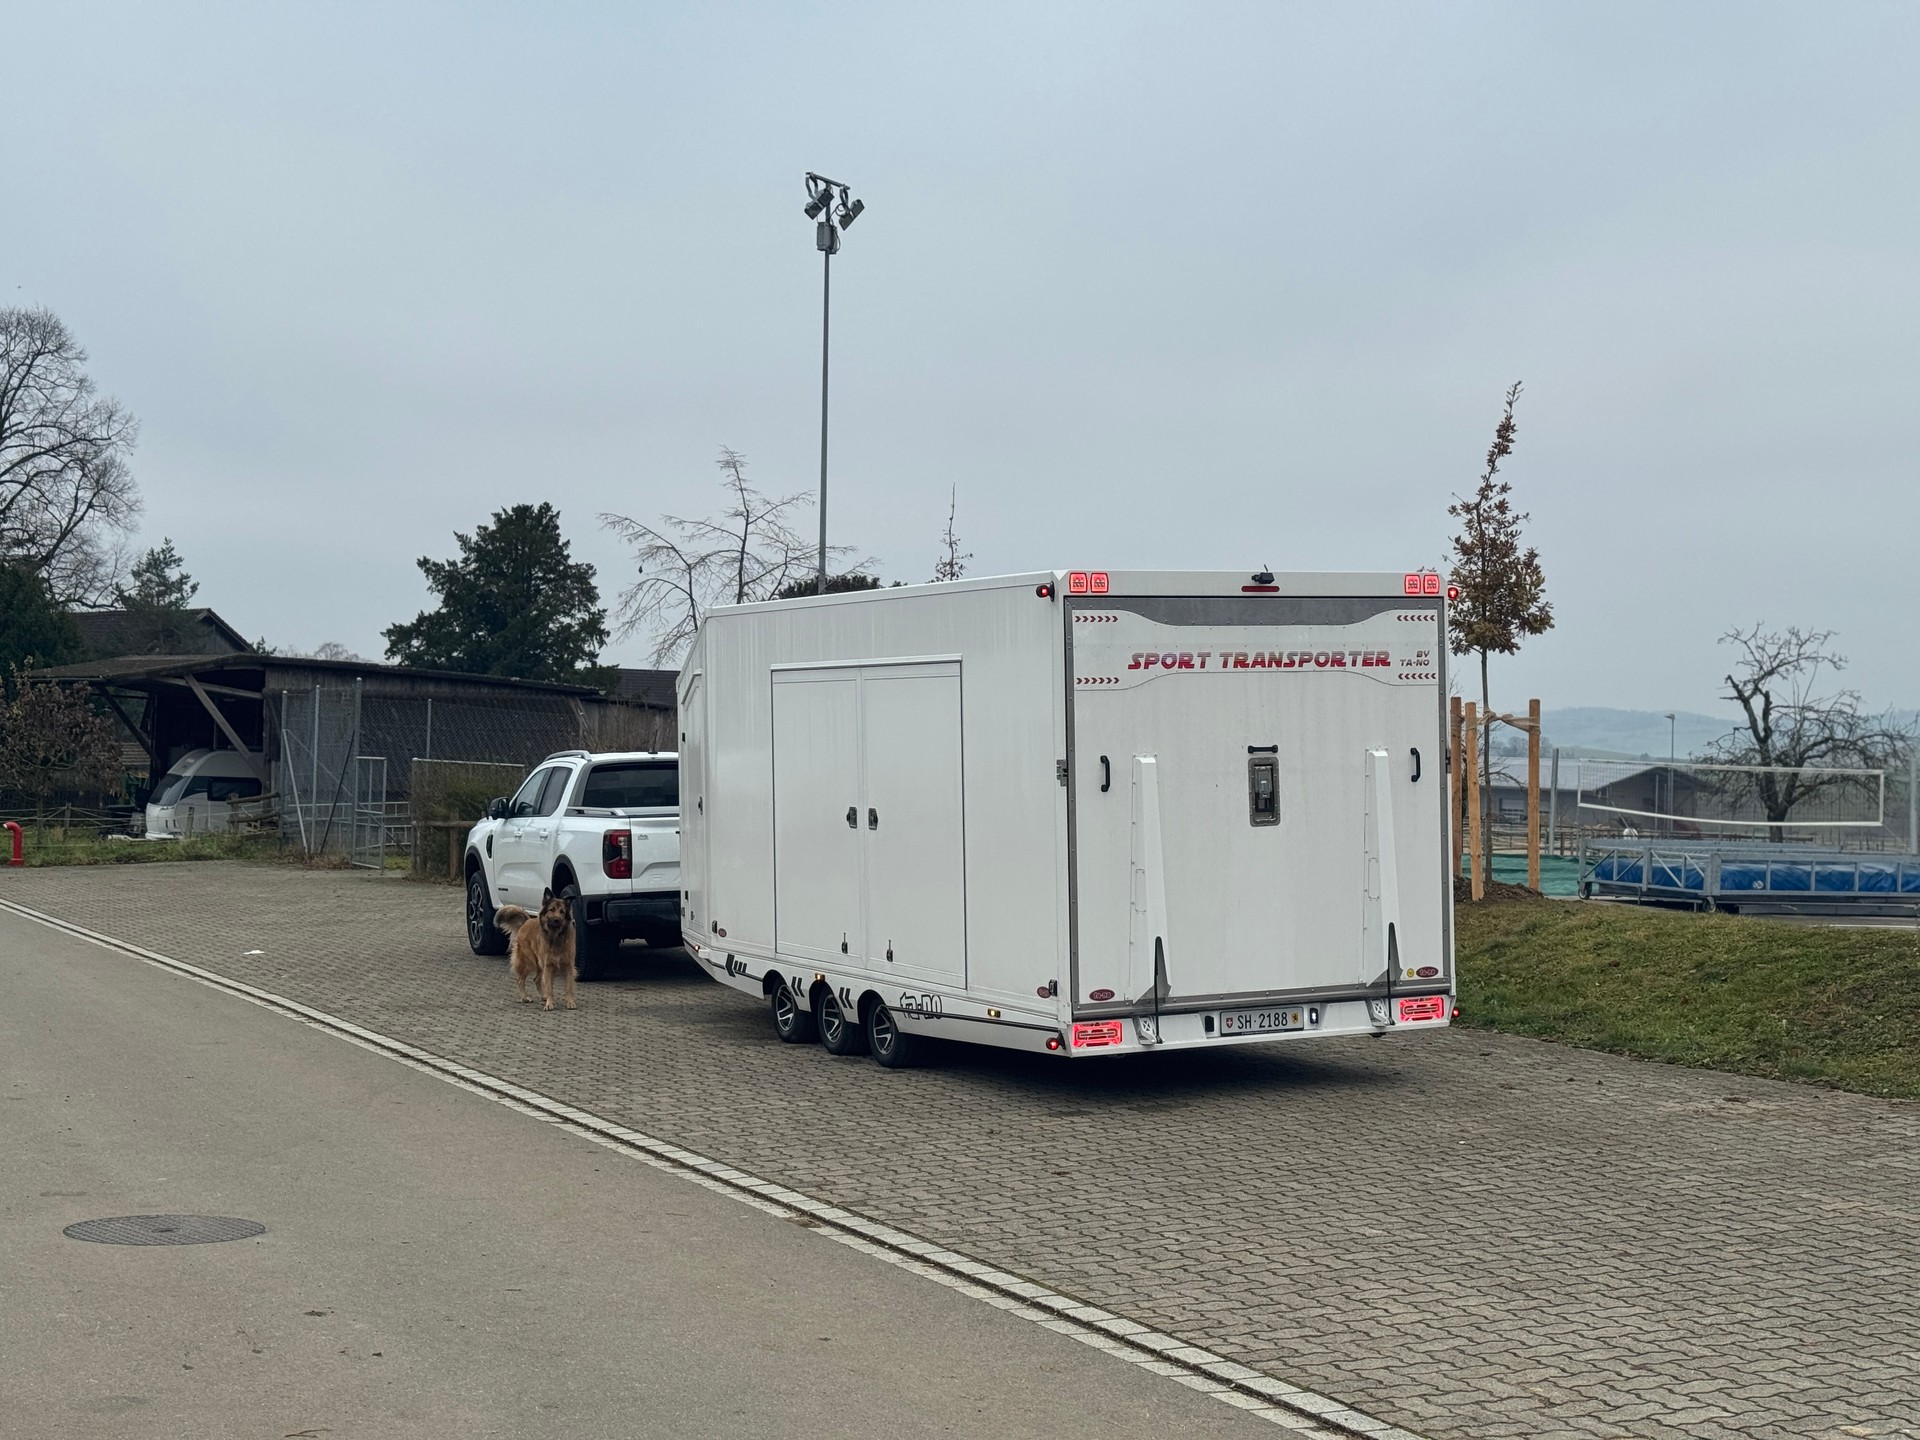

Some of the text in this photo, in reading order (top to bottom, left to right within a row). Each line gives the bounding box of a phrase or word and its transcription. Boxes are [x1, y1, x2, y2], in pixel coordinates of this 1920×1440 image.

[1416, 650, 1430, 658] BY
[1128, 651, 1391, 670] SPORT TRANSPORTER
[1400, 659, 1430, 667] TA-NO
